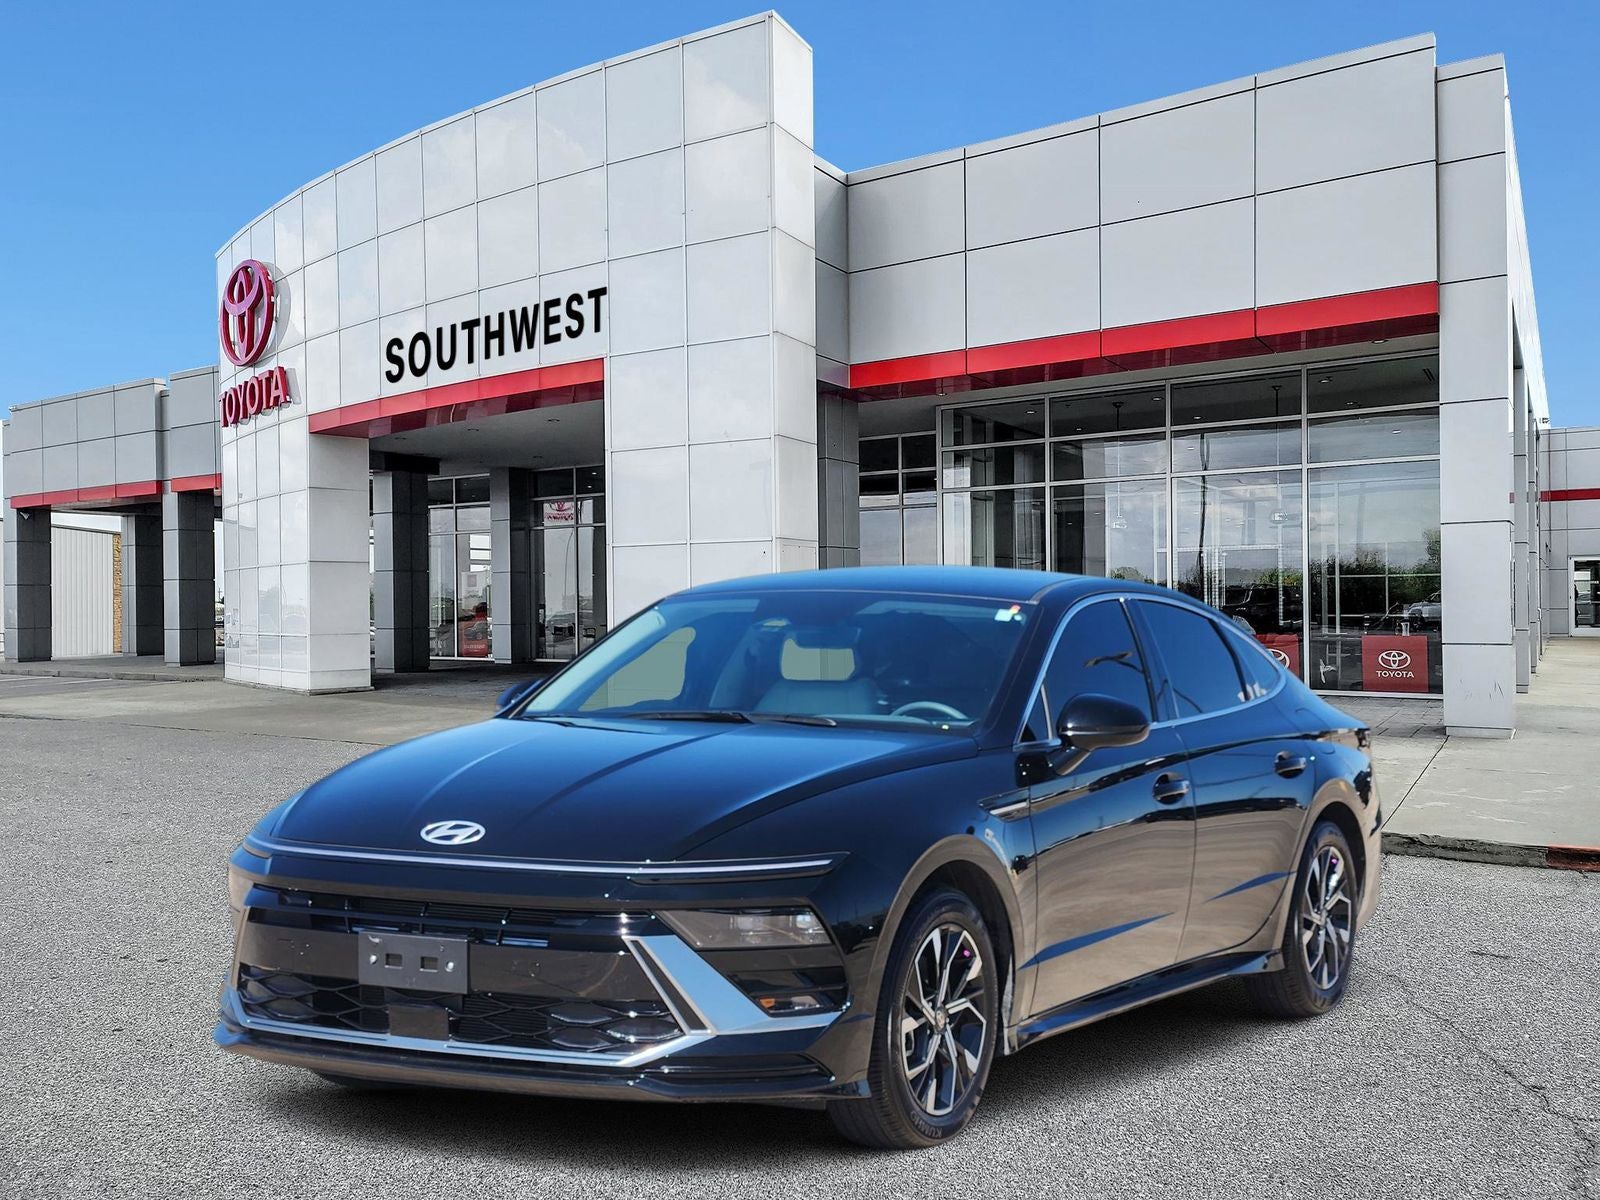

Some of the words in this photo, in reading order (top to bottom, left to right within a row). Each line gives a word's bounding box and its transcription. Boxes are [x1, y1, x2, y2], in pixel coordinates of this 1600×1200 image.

[385, 286, 608, 384] SOUTHWEST
[219, 366, 290, 428] TOYOTA
[1375, 670, 1415, 678] TOYOTA
[910, 1110, 943, 1138] KUMHO
